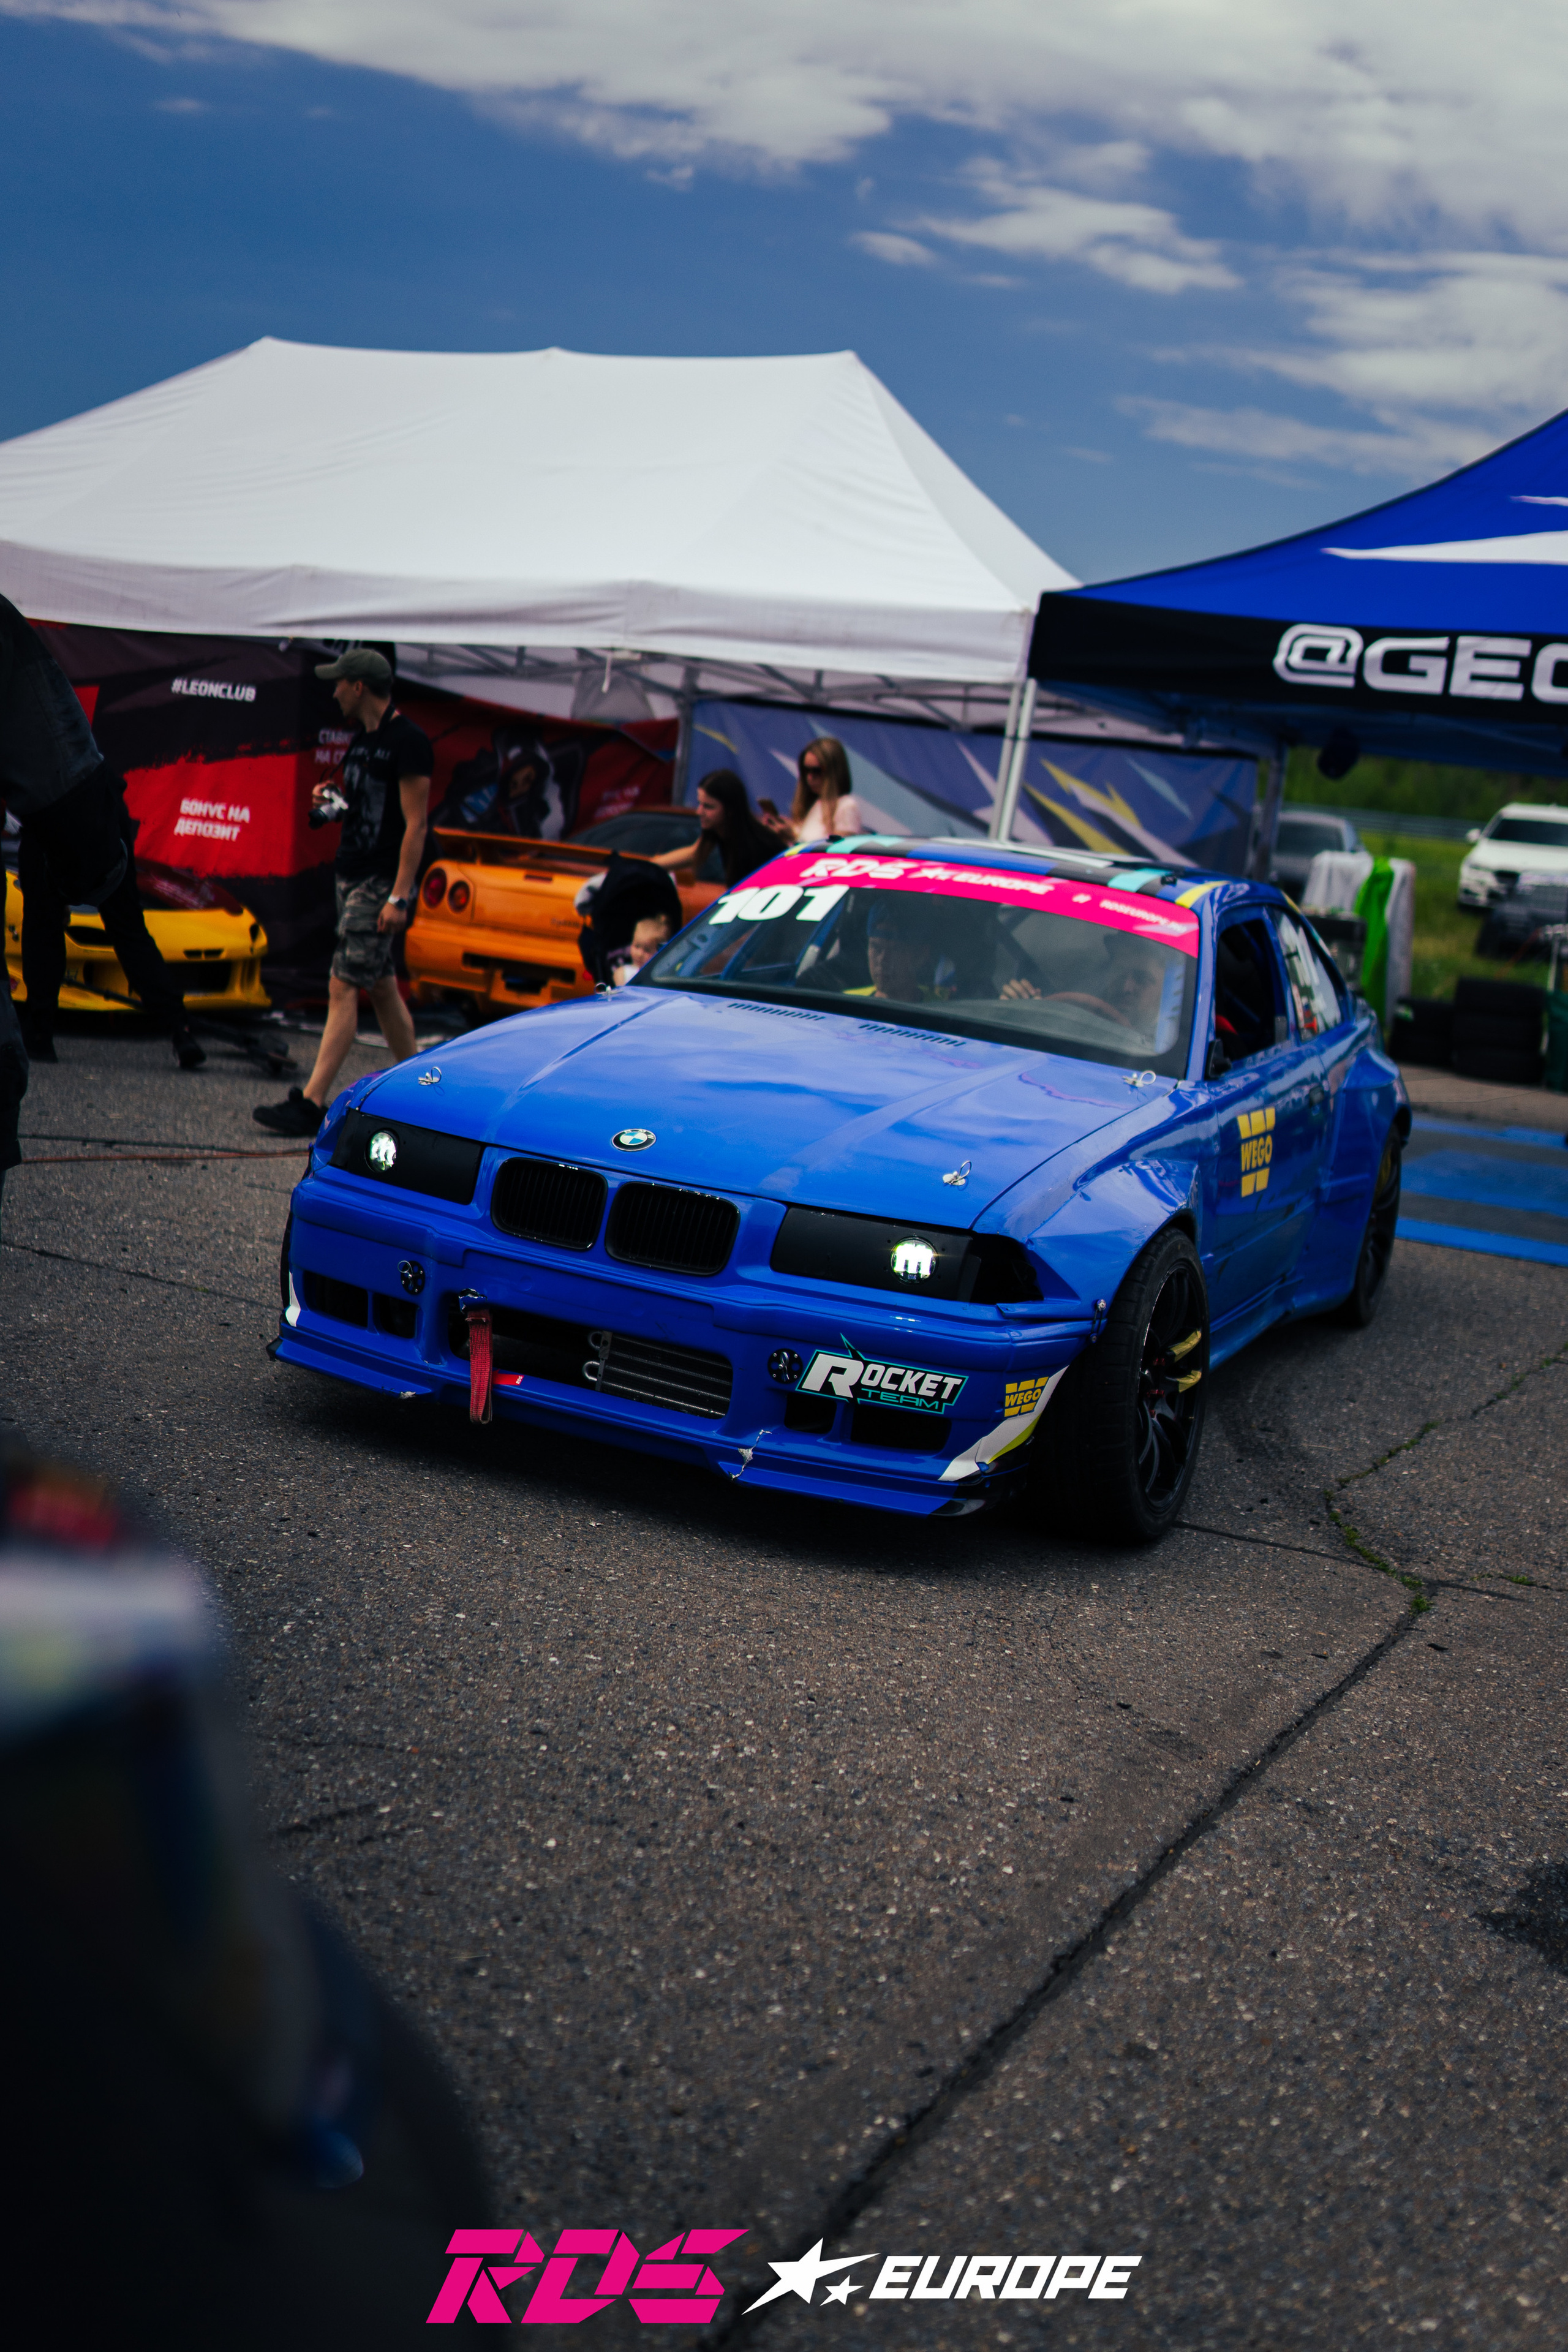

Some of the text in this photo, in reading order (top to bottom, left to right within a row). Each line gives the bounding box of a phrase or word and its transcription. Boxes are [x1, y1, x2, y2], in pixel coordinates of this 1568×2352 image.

[171, 677, 257, 703] #LEONCLUB
[179, 797, 251, 824] БОНУС НА
[173, 816, 241, 842] ДЕПОЗИТ
[799, 857, 1055, 895] RDS EUROPE
[709, 883, 850, 925] 101
[1240, 1134, 1273, 1172] WEGO
[801, 1353, 963, 1400] ROCKET
[861, 1387, 940, 1410] TEAM
[1005, 1387, 1042, 1407] WEGO
